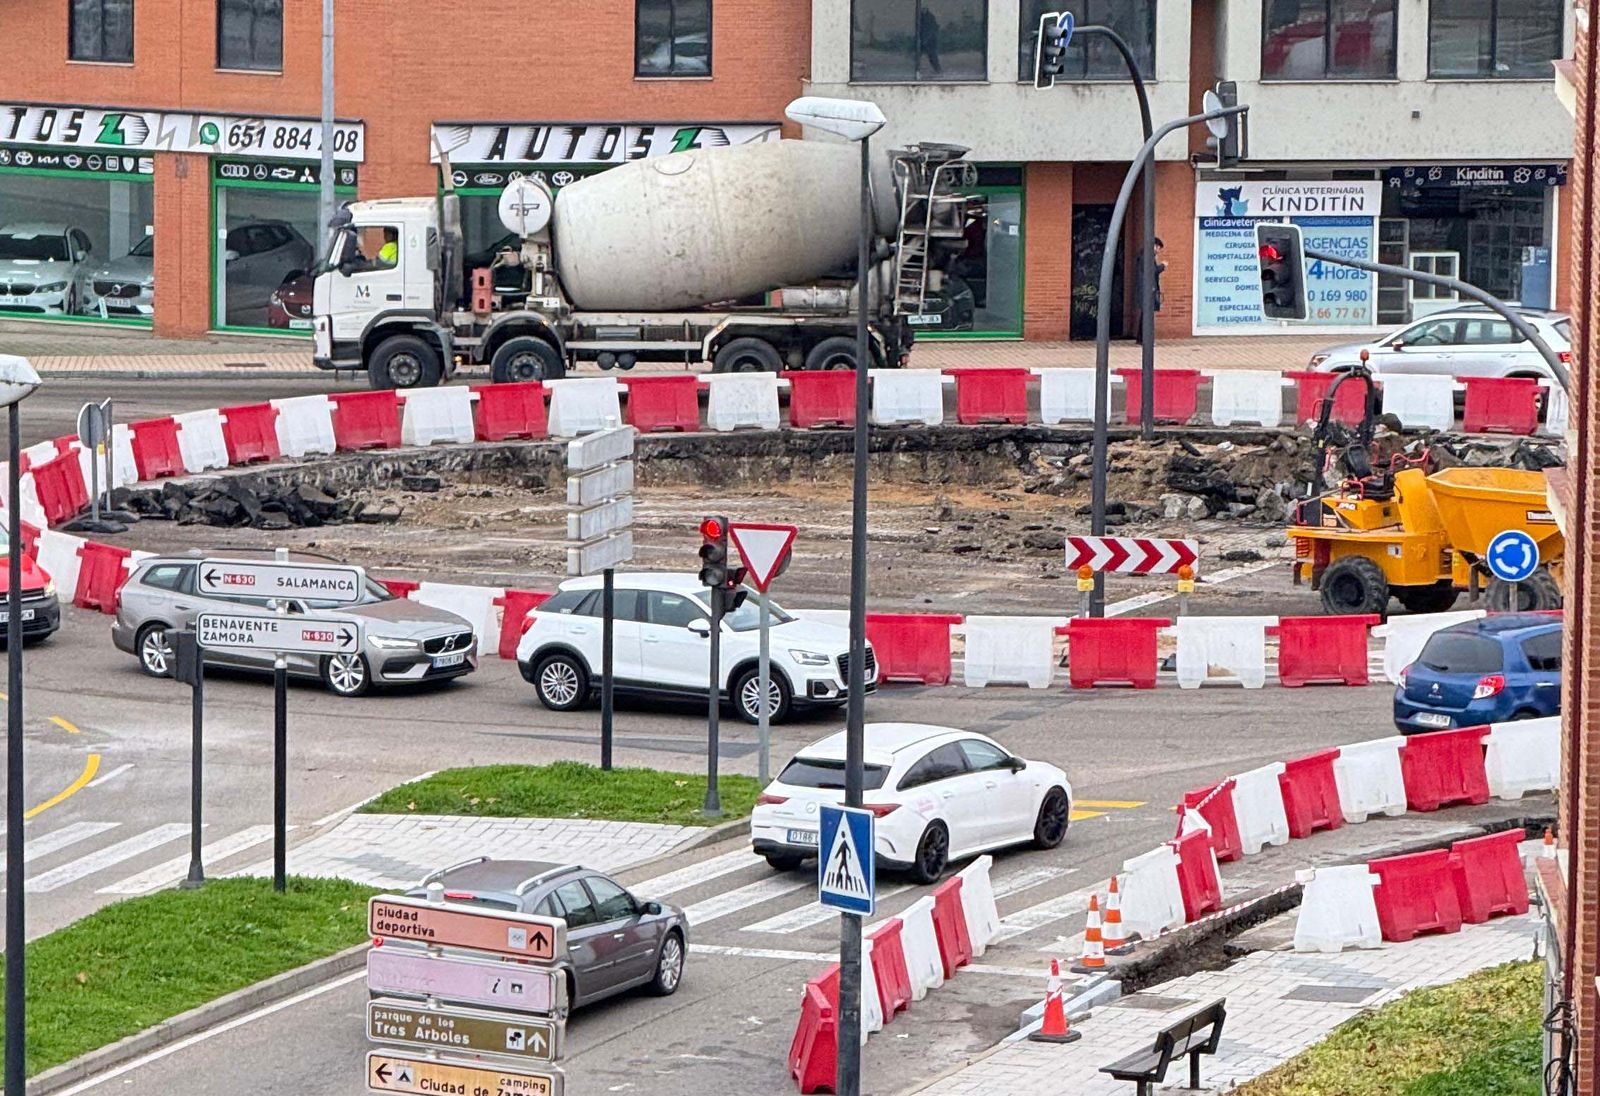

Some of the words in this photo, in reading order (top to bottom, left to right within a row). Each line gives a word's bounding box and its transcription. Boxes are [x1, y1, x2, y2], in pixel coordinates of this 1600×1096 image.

[5, 107, 86, 142] TOS
[228, 124, 267, 148] 651
[273, 126, 313, 151] 884
[318, 129, 359, 153] 08
[481, 126, 653, 160] AUTOS
[1262, 186, 1300, 195] CLÍNICA
[1303, 187, 1365, 195] VETERINARIA
[1262, 194, 1365, 212] KINDITÍN
[1303, 237, 1368, 249] RGENCIAS
[1320, 290, 1341, 302] 169
[1345, 290, 1368, 302] 980
[1317, 308, 1331, 319] 66
[1335, 308, 1349, 319] 77
[1352, 308, 1367, 319] 67
[277, 577, 354, 591] SALAMANCA
[203, 618, 278, 632] BENAVENTE
[203, 632, 255, 643] ZAMORA
[377, 906, 418, 922] ciudad
[376, 920, 435, 938] deportiva
[374, 1010, 412, 1023] parque
[418, 1012, 432, 1025] de
[438, 1016, 454, 1028] los
[374, 1021, 406, 1037] Tres
[415, 1026, 470, 1044] Arboles
[420, 1078, 465, 1095] Ciudad
[473, 1086, 489, 1096] de
[500, 1078, 546, 1093] camping
